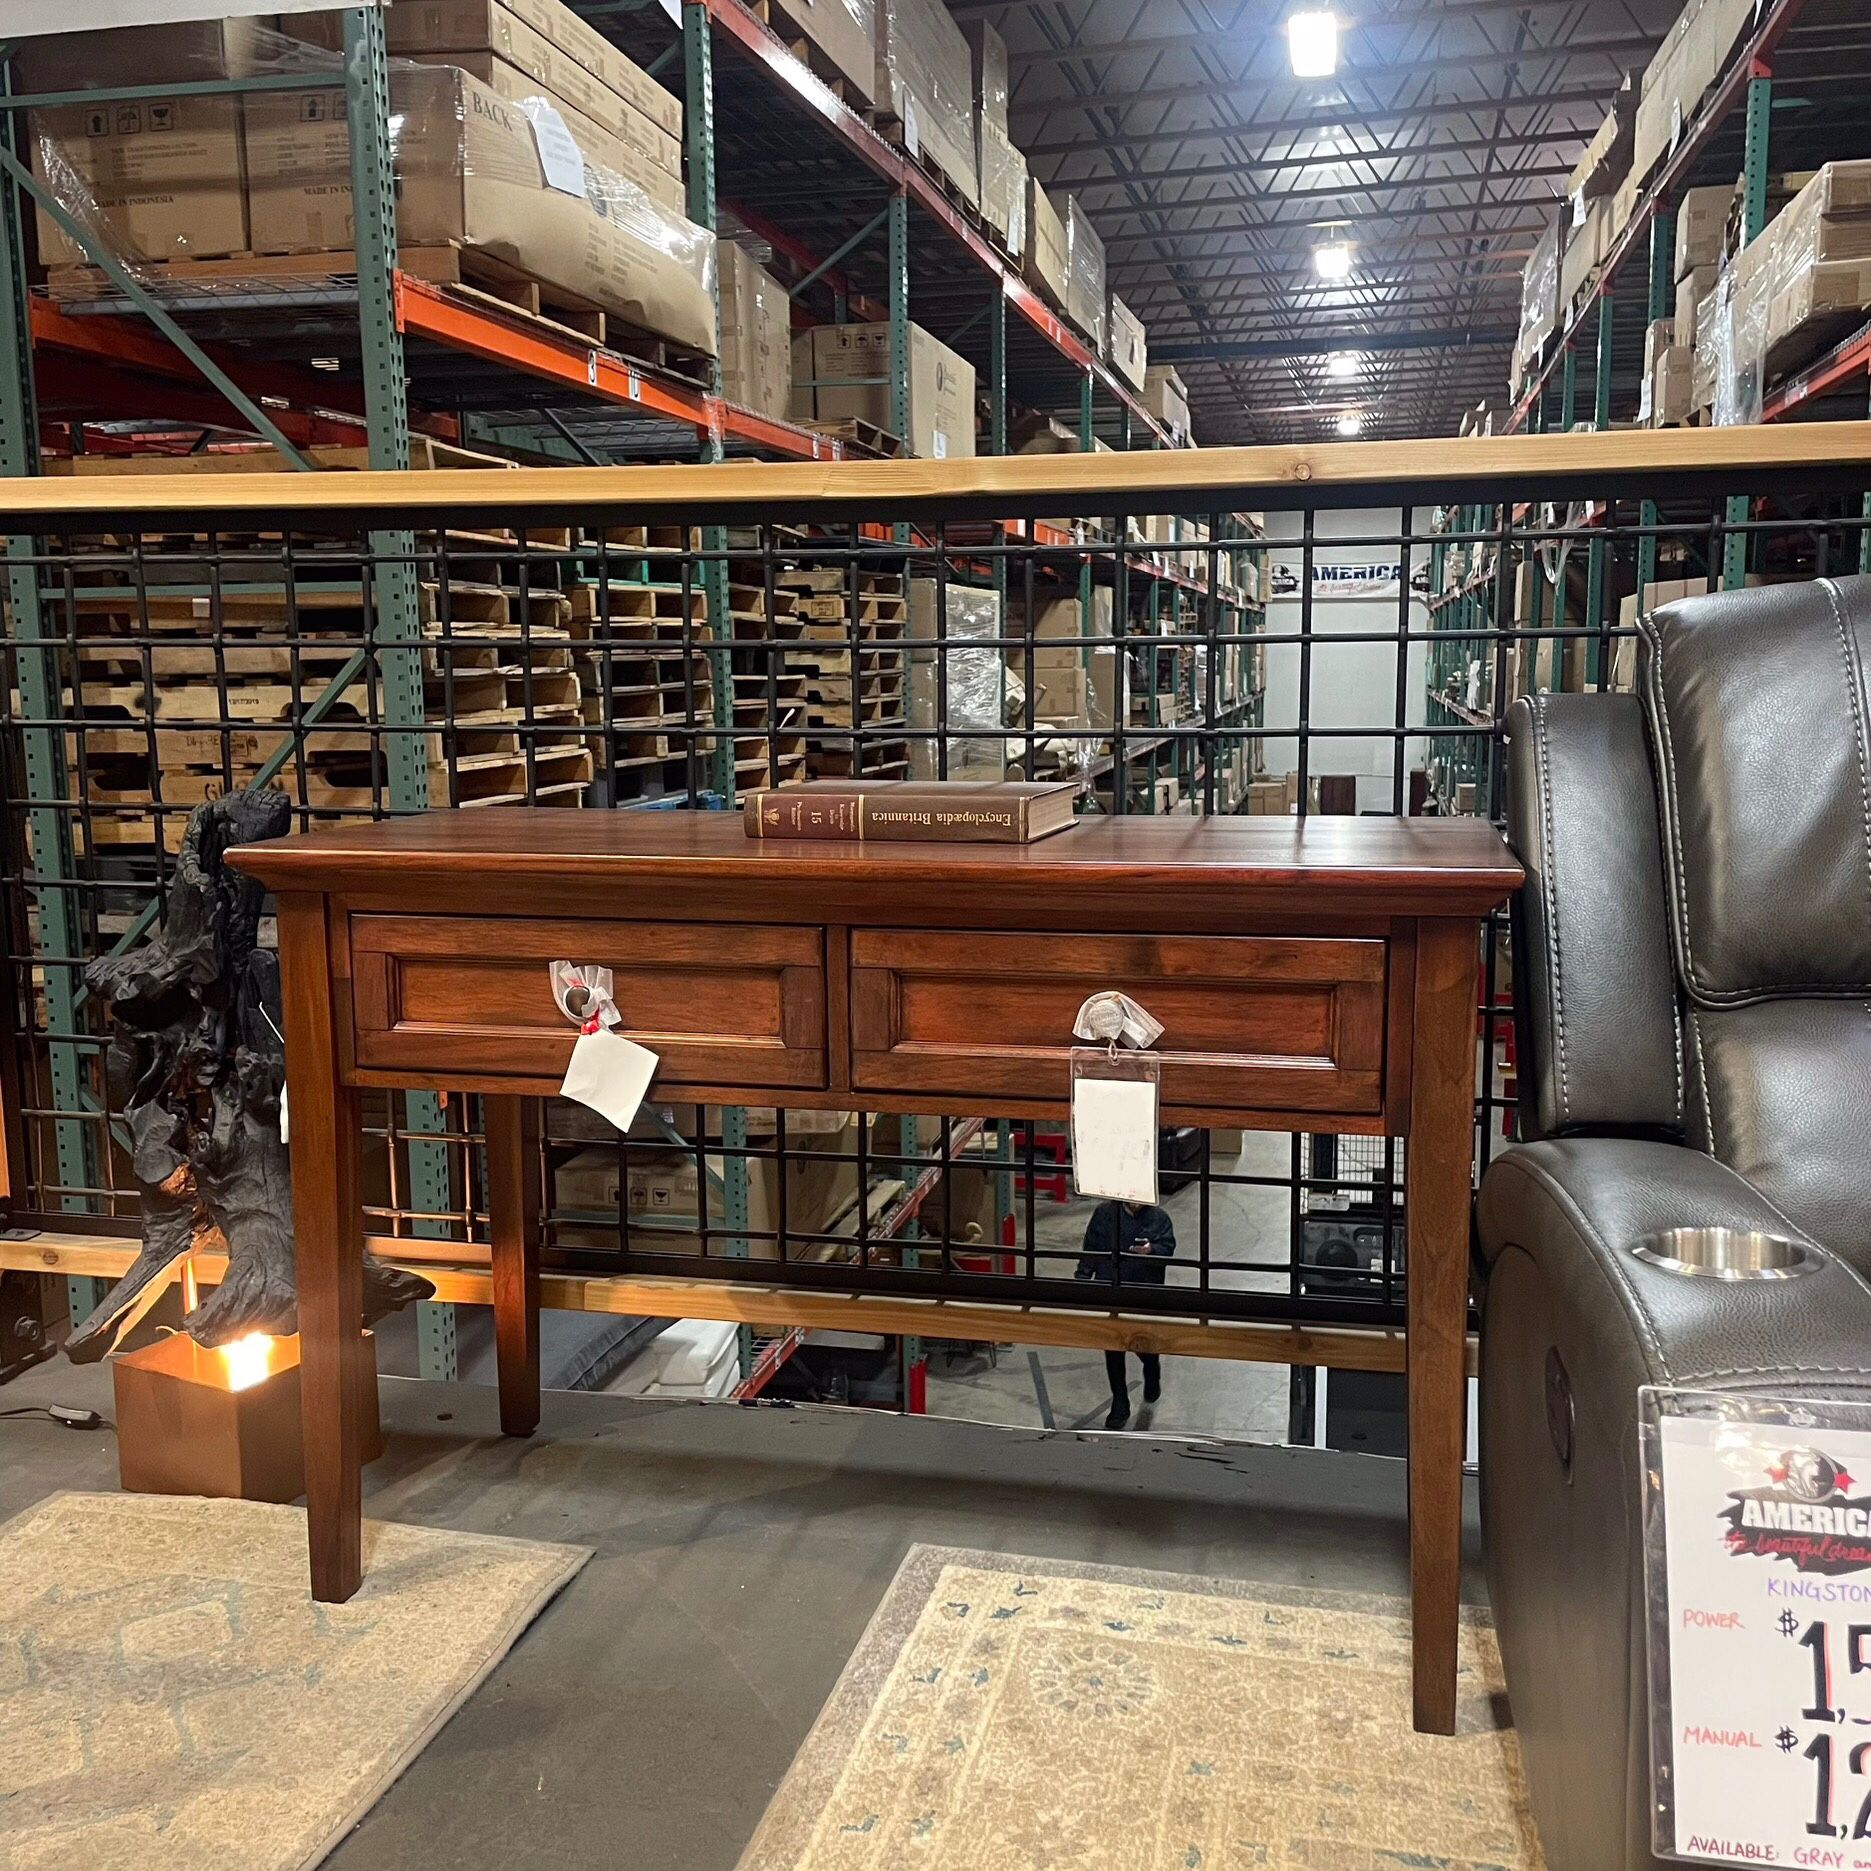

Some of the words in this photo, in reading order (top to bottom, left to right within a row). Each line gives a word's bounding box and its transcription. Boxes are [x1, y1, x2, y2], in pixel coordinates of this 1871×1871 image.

[472, 91, 513, 131] BACK
[810, 811, 822, 825] 15
[871, 811, 932, 826] Britannica
[1741, 1499, 1871, 1538] AMERIC
[1683, 1609, 1745, 1629] POWER
[1683, 1726, 1762, 1748] MANUAL
[1688, 1835, 1779, 1861] AVAILABLE:
[1794, 1846, 1845, 1869] GRAY
